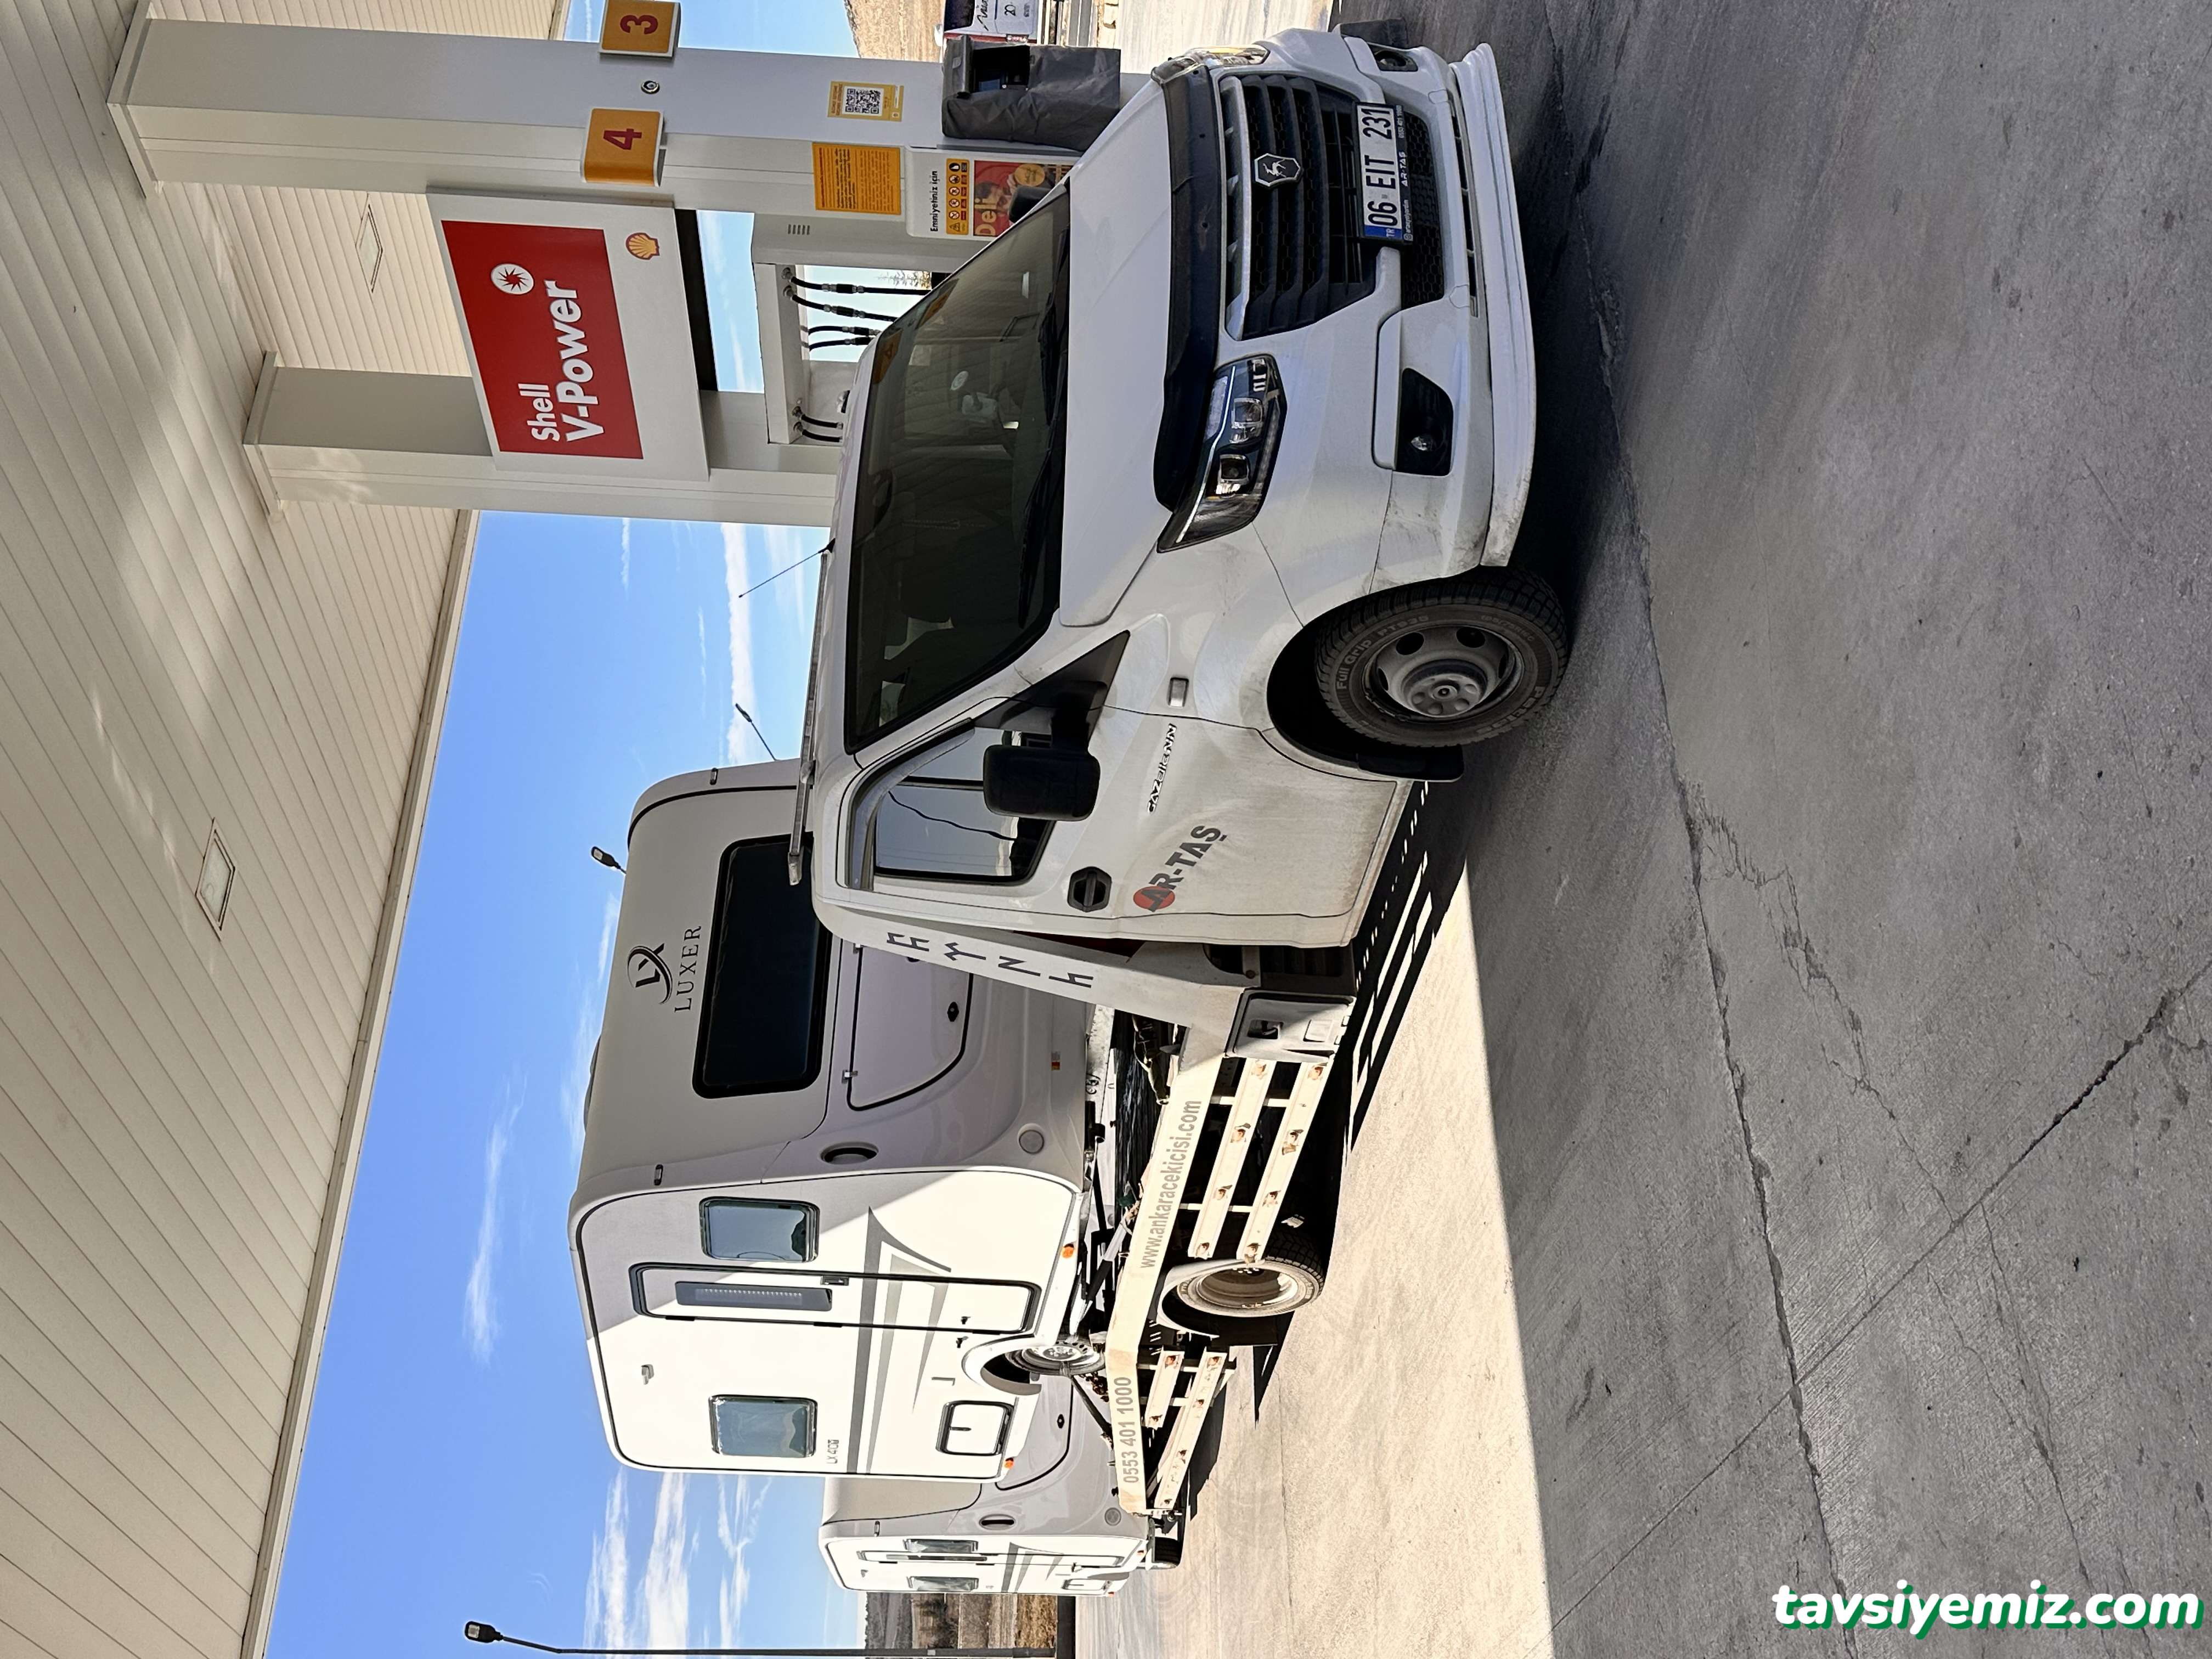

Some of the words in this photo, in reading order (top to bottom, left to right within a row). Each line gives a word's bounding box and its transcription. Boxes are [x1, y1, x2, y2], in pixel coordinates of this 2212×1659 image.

[620, 14, 658, 35] 3
[603, 128, 642, 151] 4
[1361, 108, 1392, 139] 231
[929, 171, 940, 184] için
[1364, 155, 1396, 189] EIT
[929, 187, 940, 232] Emniyetiniz
[974, 198, 997, 236] Deli
[1368, 201, 1397, 226] 06
[1386, 228, 1395, 237] TR
[544, 280, 605, 442] V-Power
[518, 383, 561, 441] Shell
[1336, 667, 1350, 689] Full
[1344, 640, 1372, 664] Grip
[674, 926, 702, 1013] LUXER
[1138, 1100, 1203, 1269] www.ankaracekicisi.com
[1114, 1377, 1134, 1415] 1000
[1117, 1421, 1136, 1447] 401
[1119, 1451, 1139, 1483] 0553
